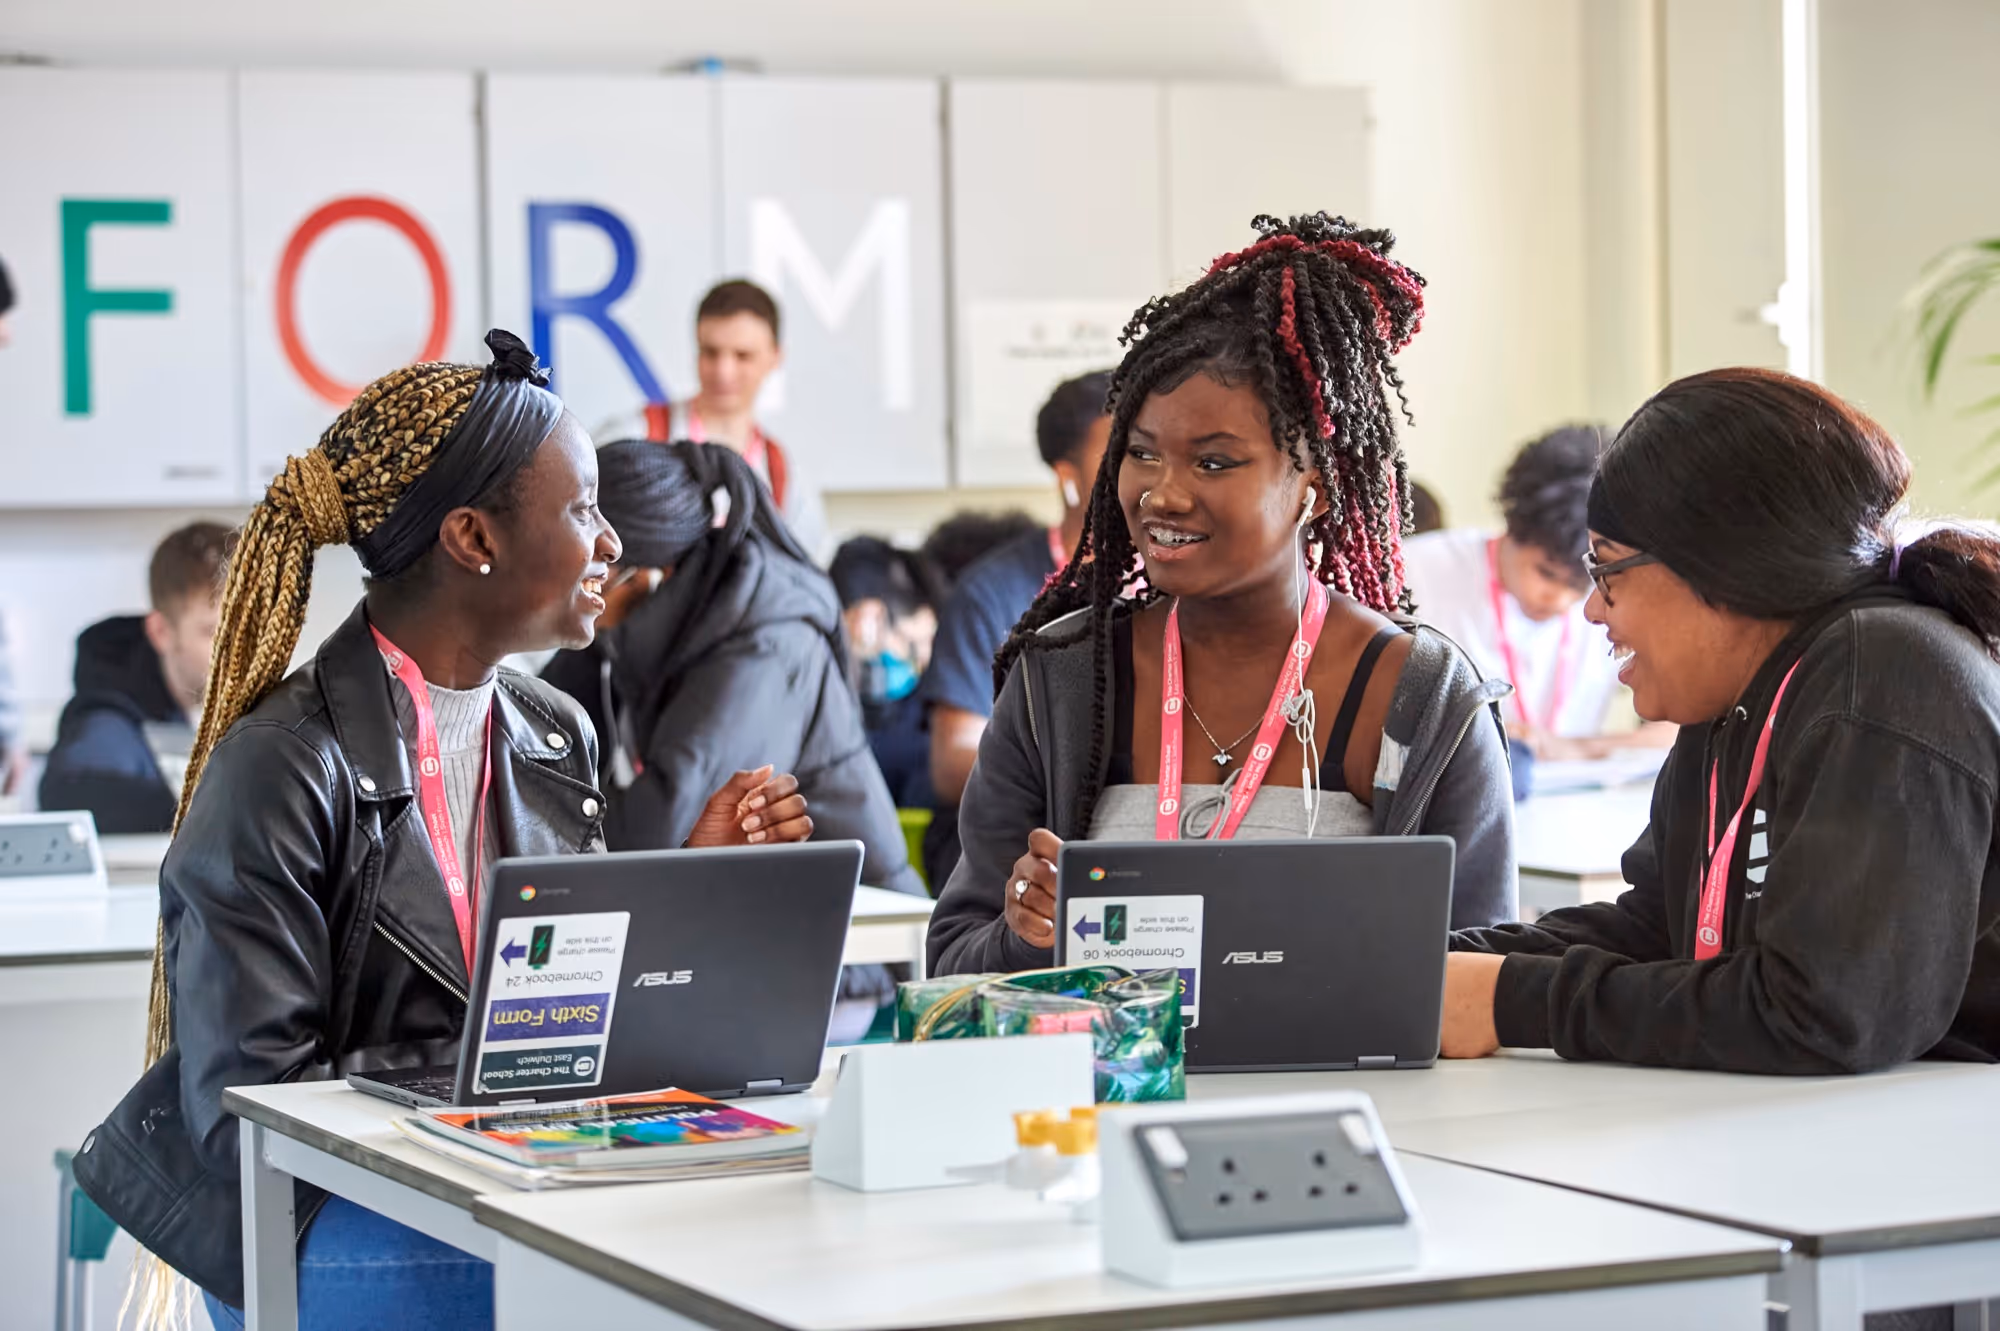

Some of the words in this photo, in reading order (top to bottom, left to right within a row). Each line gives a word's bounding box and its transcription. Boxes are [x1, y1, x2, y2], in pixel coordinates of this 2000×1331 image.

[59, 191, 911, 417] FORM
[430, 813, 440, 836] School
[1133, 926, 1163, 934] charge
[557, 947, 586, 956] charge
[1083, 949, 1100, 960] 06
[1104, 947, 1185, 959] Chromebook
[1221, 951, 1284, 964] ASUS
[504, 976, 521, 988] 24
[525, 970, 604, 986] Chromebook
[633, 970, 693, 987] ASUS
[493, 1008, 545, 1026] Form
[551, 1005, 600, 1025] Sixth
[516, 1055, 552, 1066] Dulwich
[553, 1053, 573, 1062] East
[483, 1069, 514, 1080] School
[515, 1066, 552, 1078] Charter
[553, 1065, 571, 1075] The
